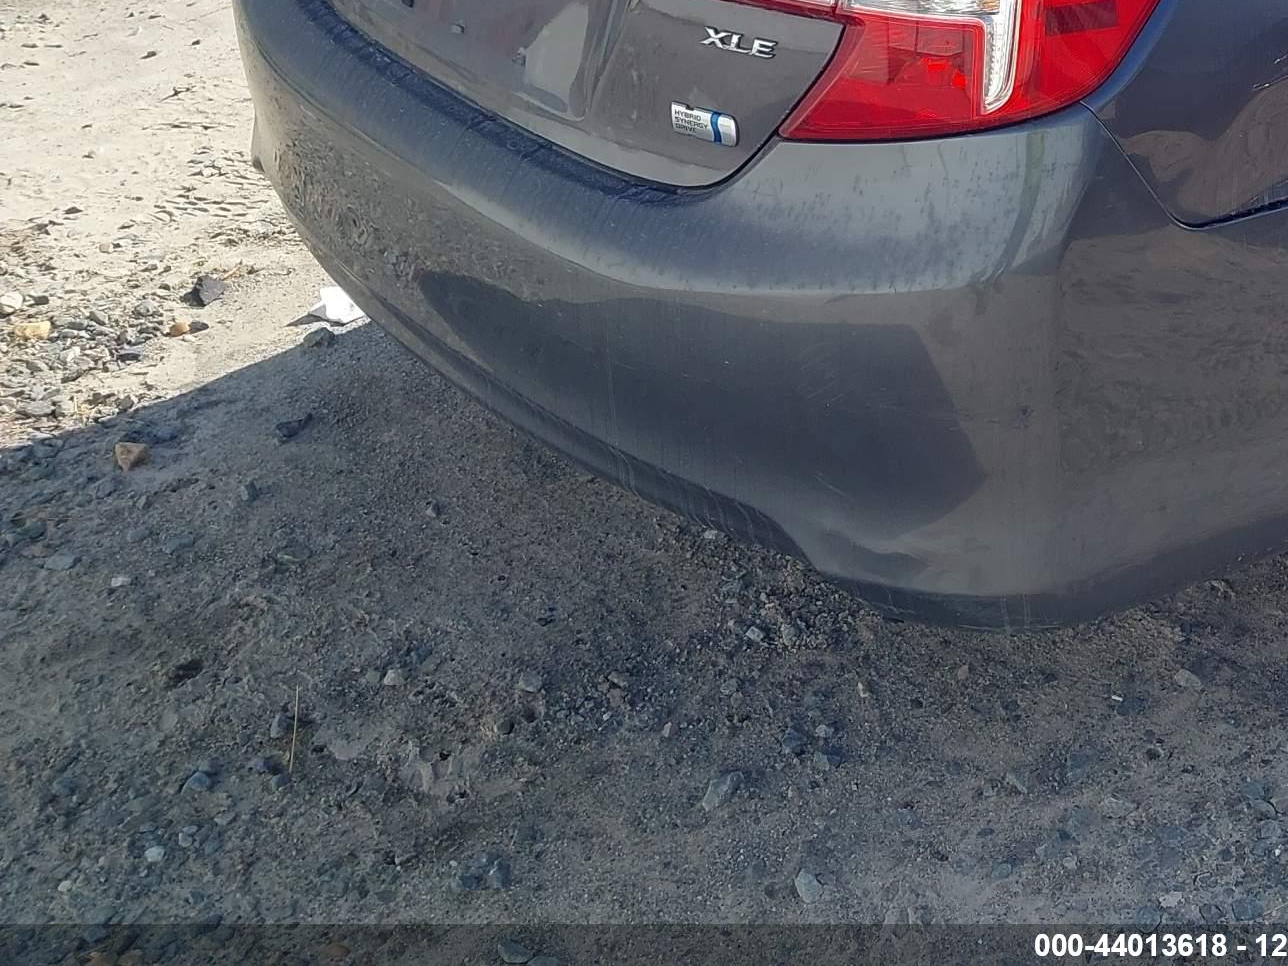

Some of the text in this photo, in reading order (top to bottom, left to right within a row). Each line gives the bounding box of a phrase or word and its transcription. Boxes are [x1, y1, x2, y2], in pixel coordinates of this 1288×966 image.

[701, 26, 778, 59] XLE
[674, 109, 702, 122] HYBRID
[674, 116, 708, 130] SYNERGY
[675, 123, 697, 133] DRIVE
